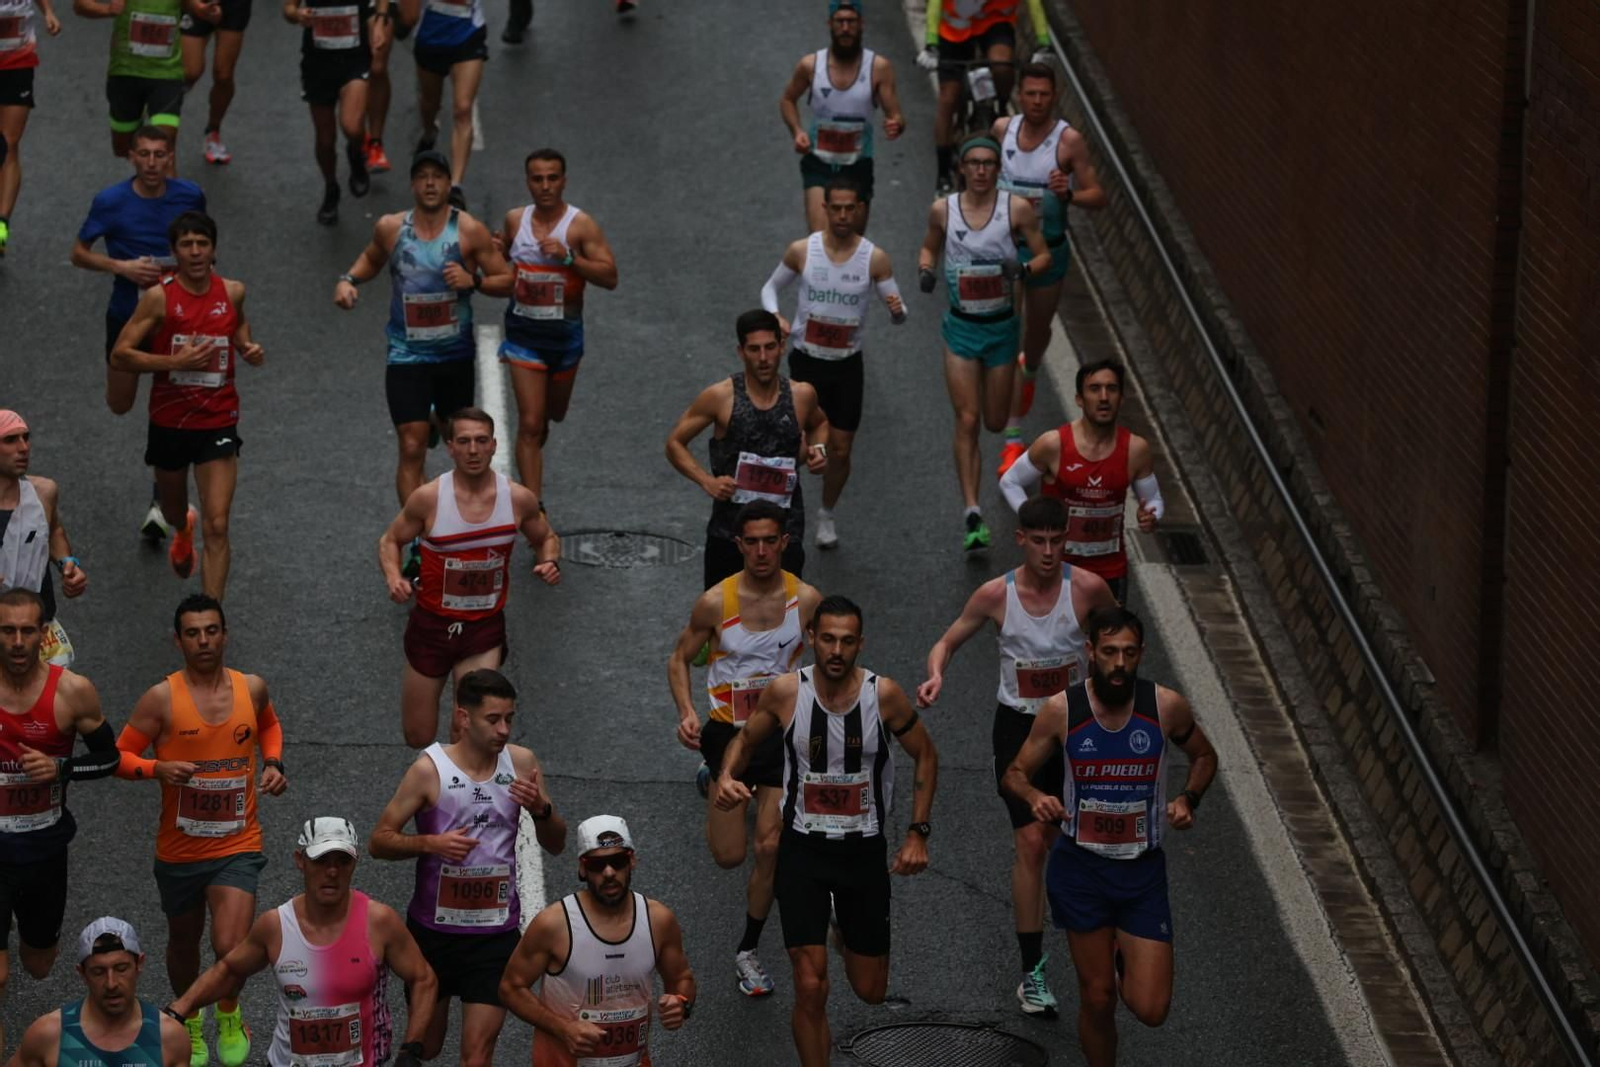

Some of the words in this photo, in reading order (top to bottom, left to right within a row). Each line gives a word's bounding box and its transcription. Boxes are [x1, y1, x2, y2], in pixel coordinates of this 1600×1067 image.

[807, 286, 860, 306] bathco
[458, 571, 488, 588] 474
[1031, 670, 1061, 690] 620
[1075, 764, 1099, 777] C.A.
[1100, 763, 1155, 777] PUEBLA
[6, 787, 40, 807] 703
[190, 793, 232, 811] 1281
[1094, 817, 1126, 835] 509
[451, 881, 493, 900] 1096
[298, 1023, 344, 1044] 1317
[602, 1025, 635, 1045] 036
